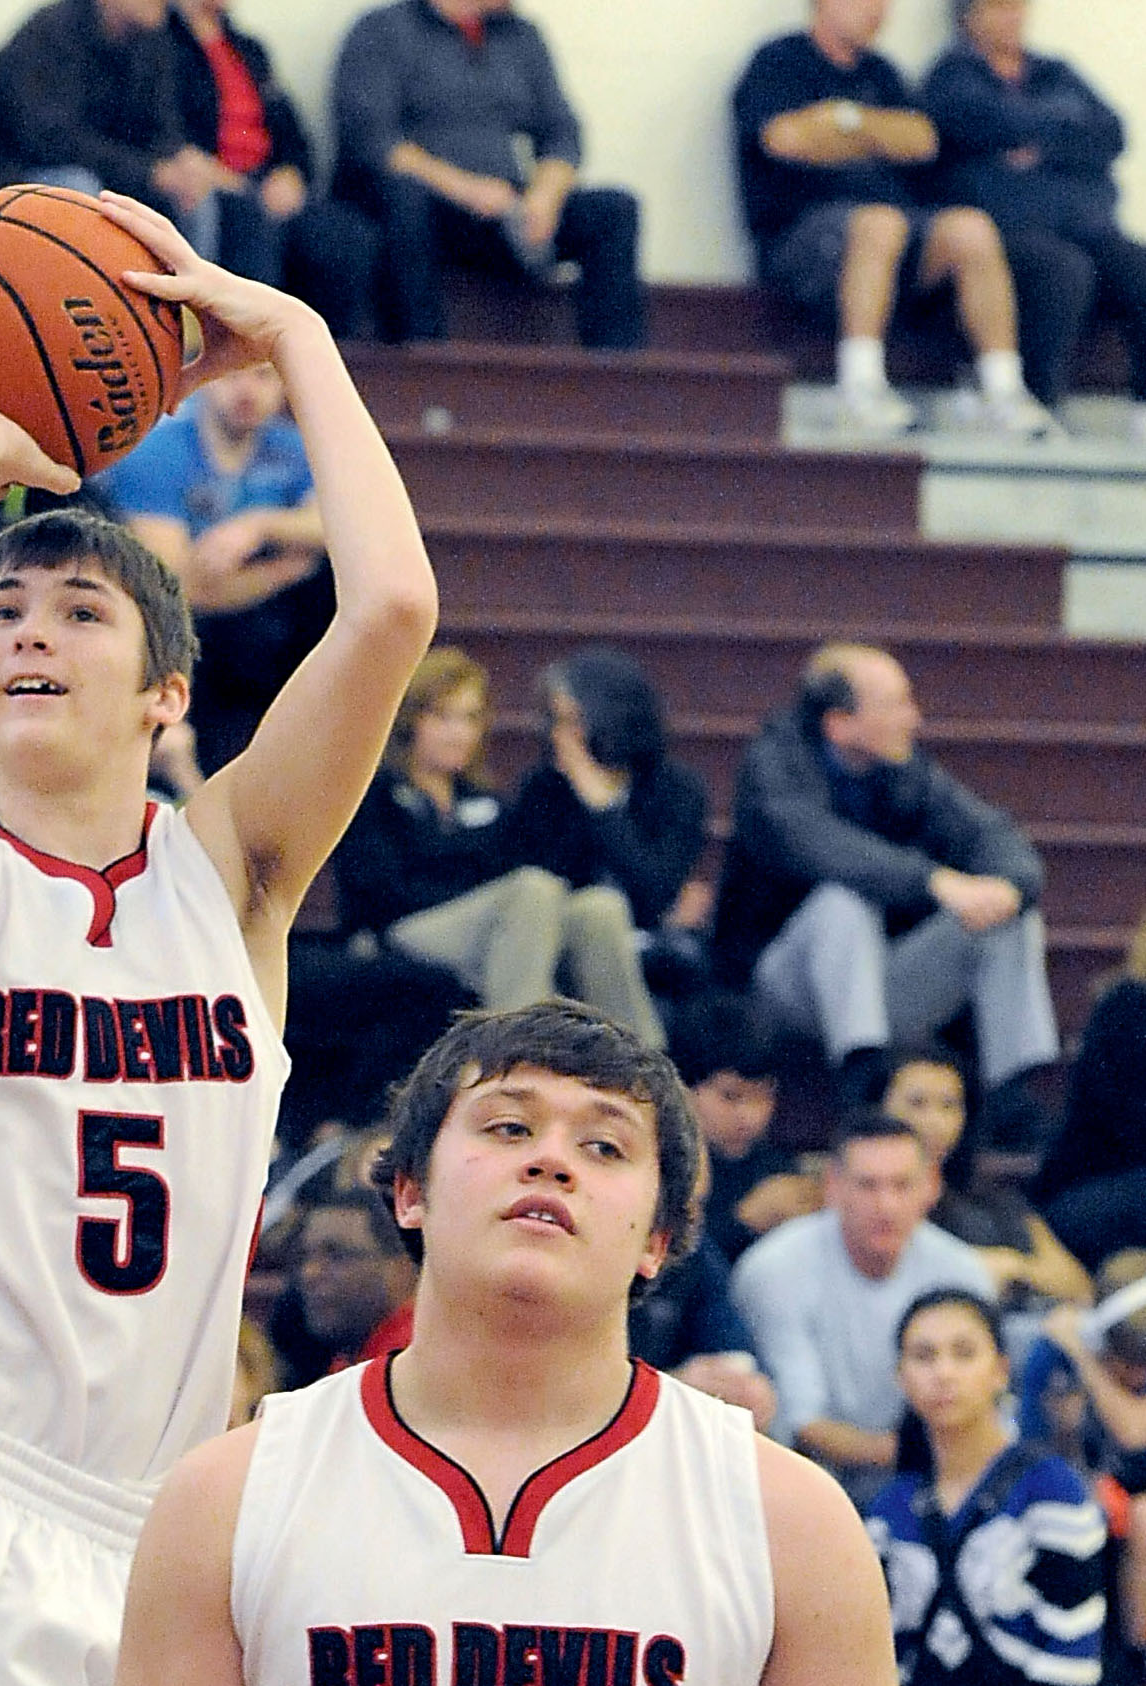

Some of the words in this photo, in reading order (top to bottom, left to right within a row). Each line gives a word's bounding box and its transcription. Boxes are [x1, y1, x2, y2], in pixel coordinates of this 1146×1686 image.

[62, 296, 139, 452] Baden
[81, 994, 255, 1083] DEVILS
[76, 1109, 171, 1296] 5
